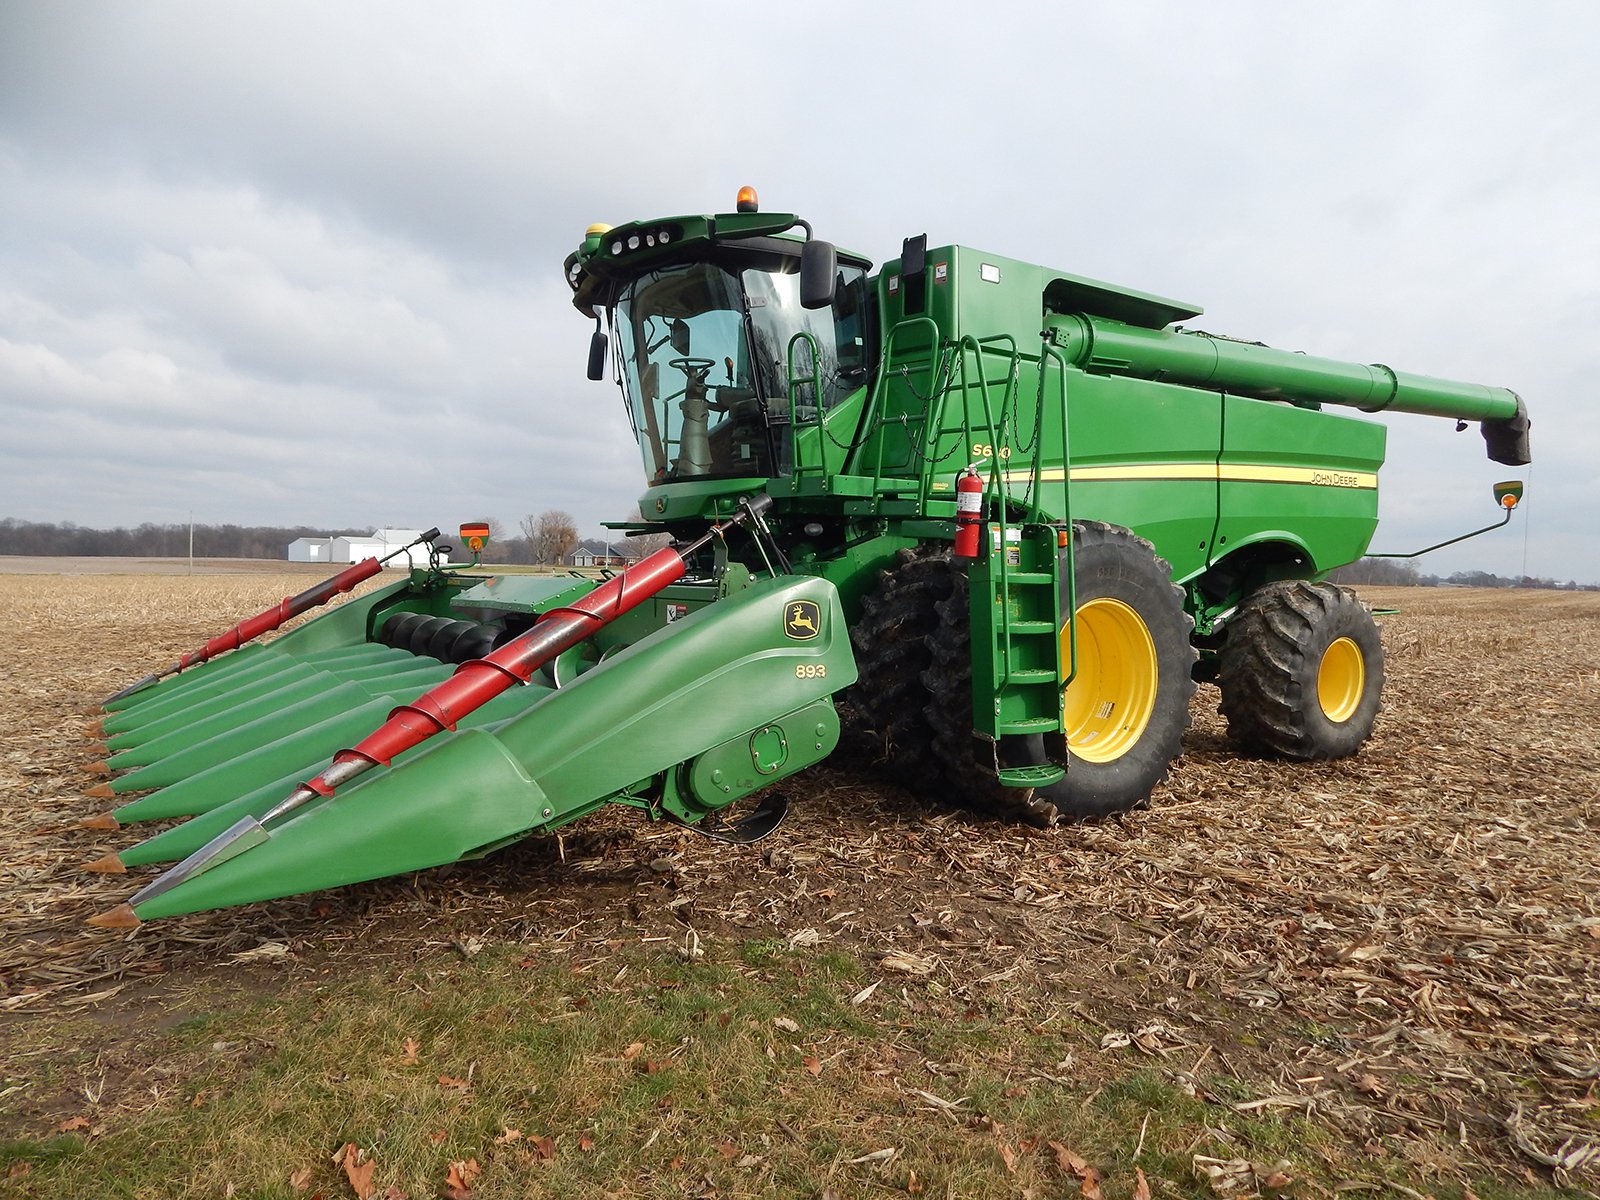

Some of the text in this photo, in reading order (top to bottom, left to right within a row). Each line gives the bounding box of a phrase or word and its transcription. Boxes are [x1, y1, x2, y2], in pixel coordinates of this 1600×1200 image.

[972, 443, 1012, 459] S60
[1311, 471, 1359, 488] JOHN DEERE
[795, 664, 826, 679] 893
